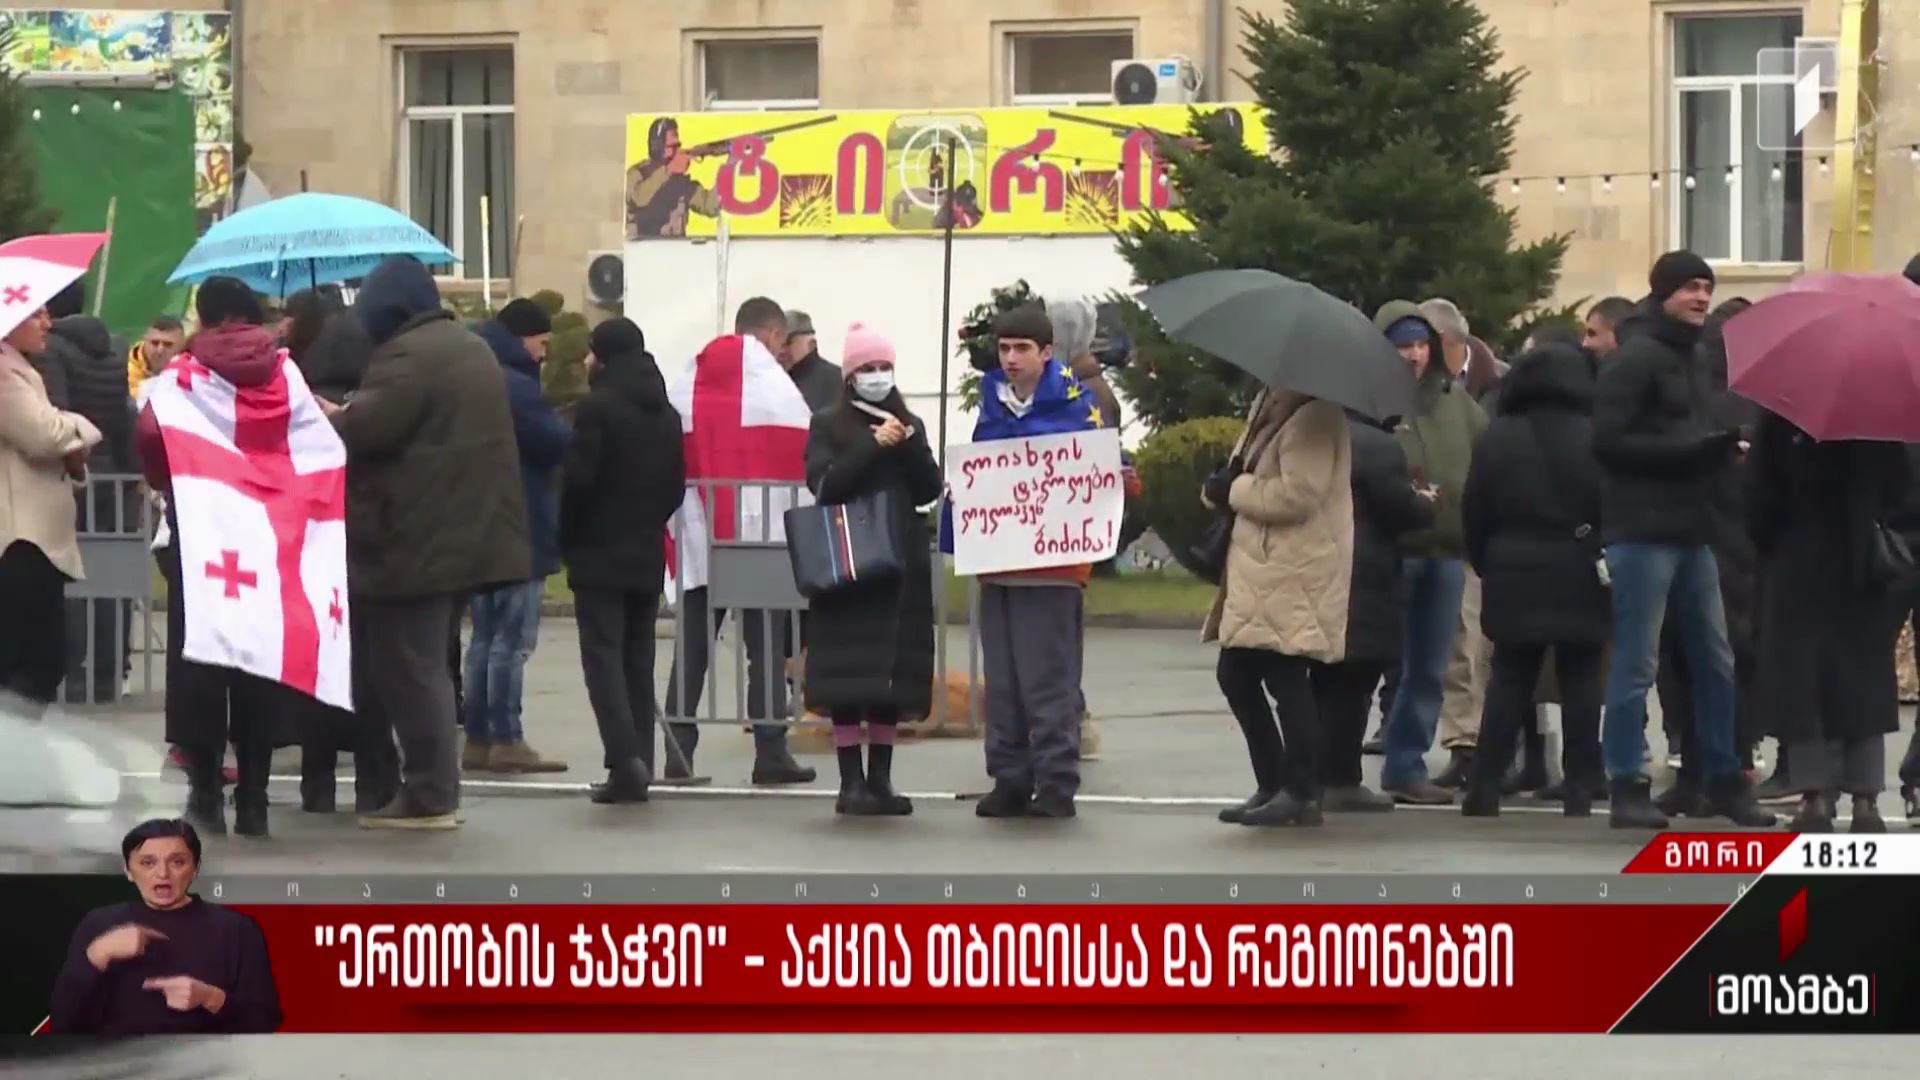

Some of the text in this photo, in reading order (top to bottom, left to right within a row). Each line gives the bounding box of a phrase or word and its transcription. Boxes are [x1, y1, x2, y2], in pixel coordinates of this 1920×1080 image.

[716, 128, 1170, 216] ტირი
[962, 437, 1083, 489] ლიახვის
[1013, 462, 1116, 505] ტალღები
[1034, 517, 1113, 555] ბიძინა!
